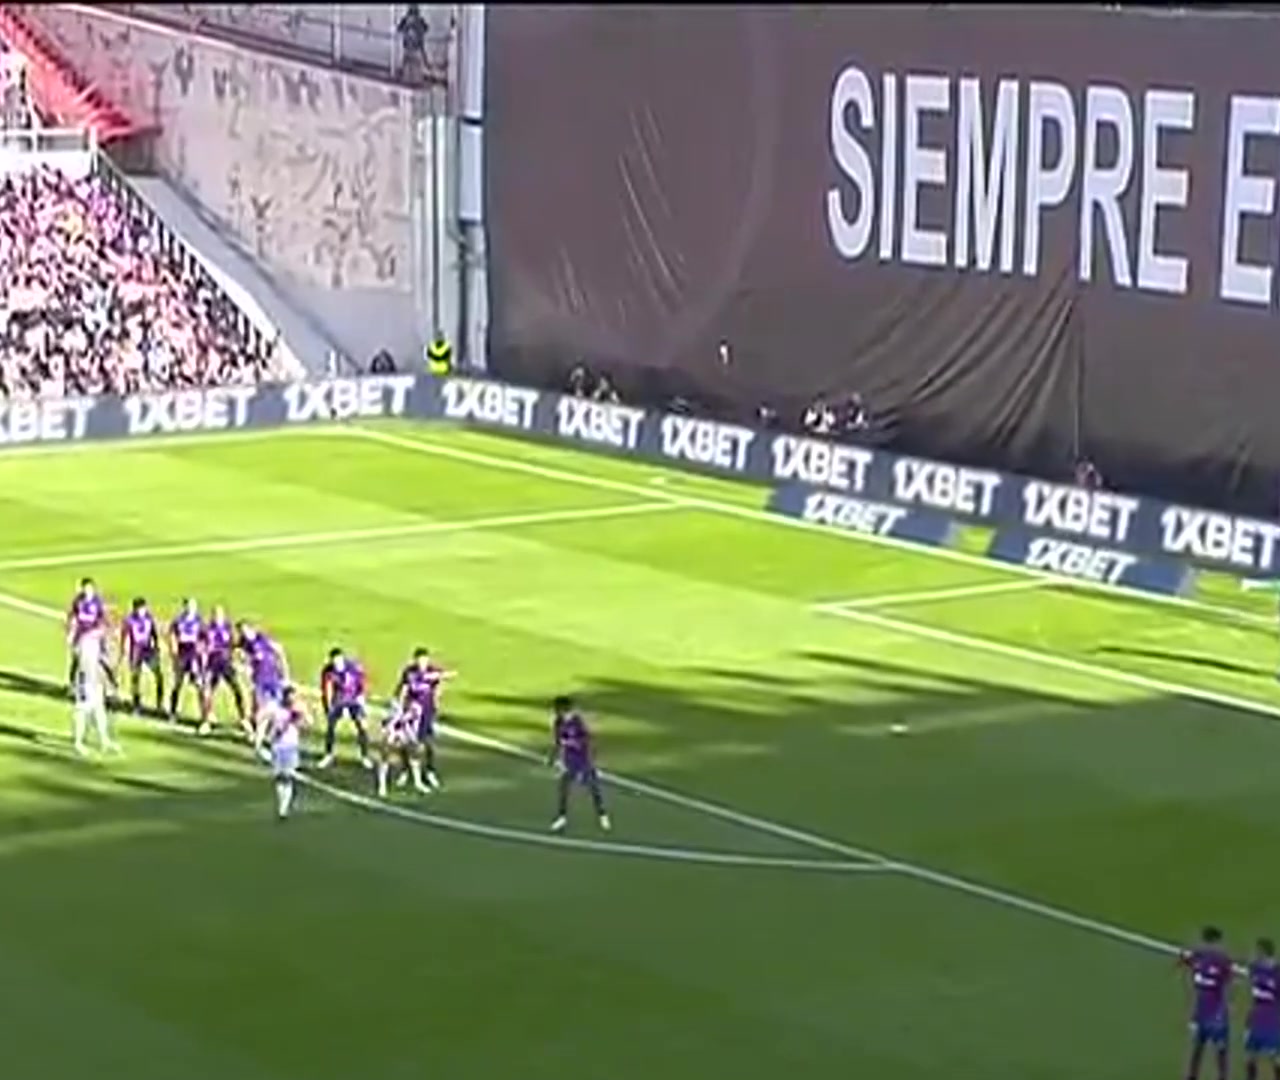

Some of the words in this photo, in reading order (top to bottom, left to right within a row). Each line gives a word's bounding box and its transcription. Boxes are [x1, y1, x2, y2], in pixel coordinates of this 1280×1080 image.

[825, 65, 1195, 294] SIEMPRE
[122, 387, 256, 433] 1XBET
[282, 377, 416, 422] 1XBET
[441, 378, 540, 429] 1XBET
[556, 395, 645, 448] 1XBET
[660, 414, 755, 470] 1XBET
[772, 435, 873, 492] 1XBET
[893, 457, 1002, 516] 1XBET
[1023, 480, 1139, 542] 1XBET
[803, 492, 908, 536] 1XBET
[1025, 537, 1137, 584] 1XBET
